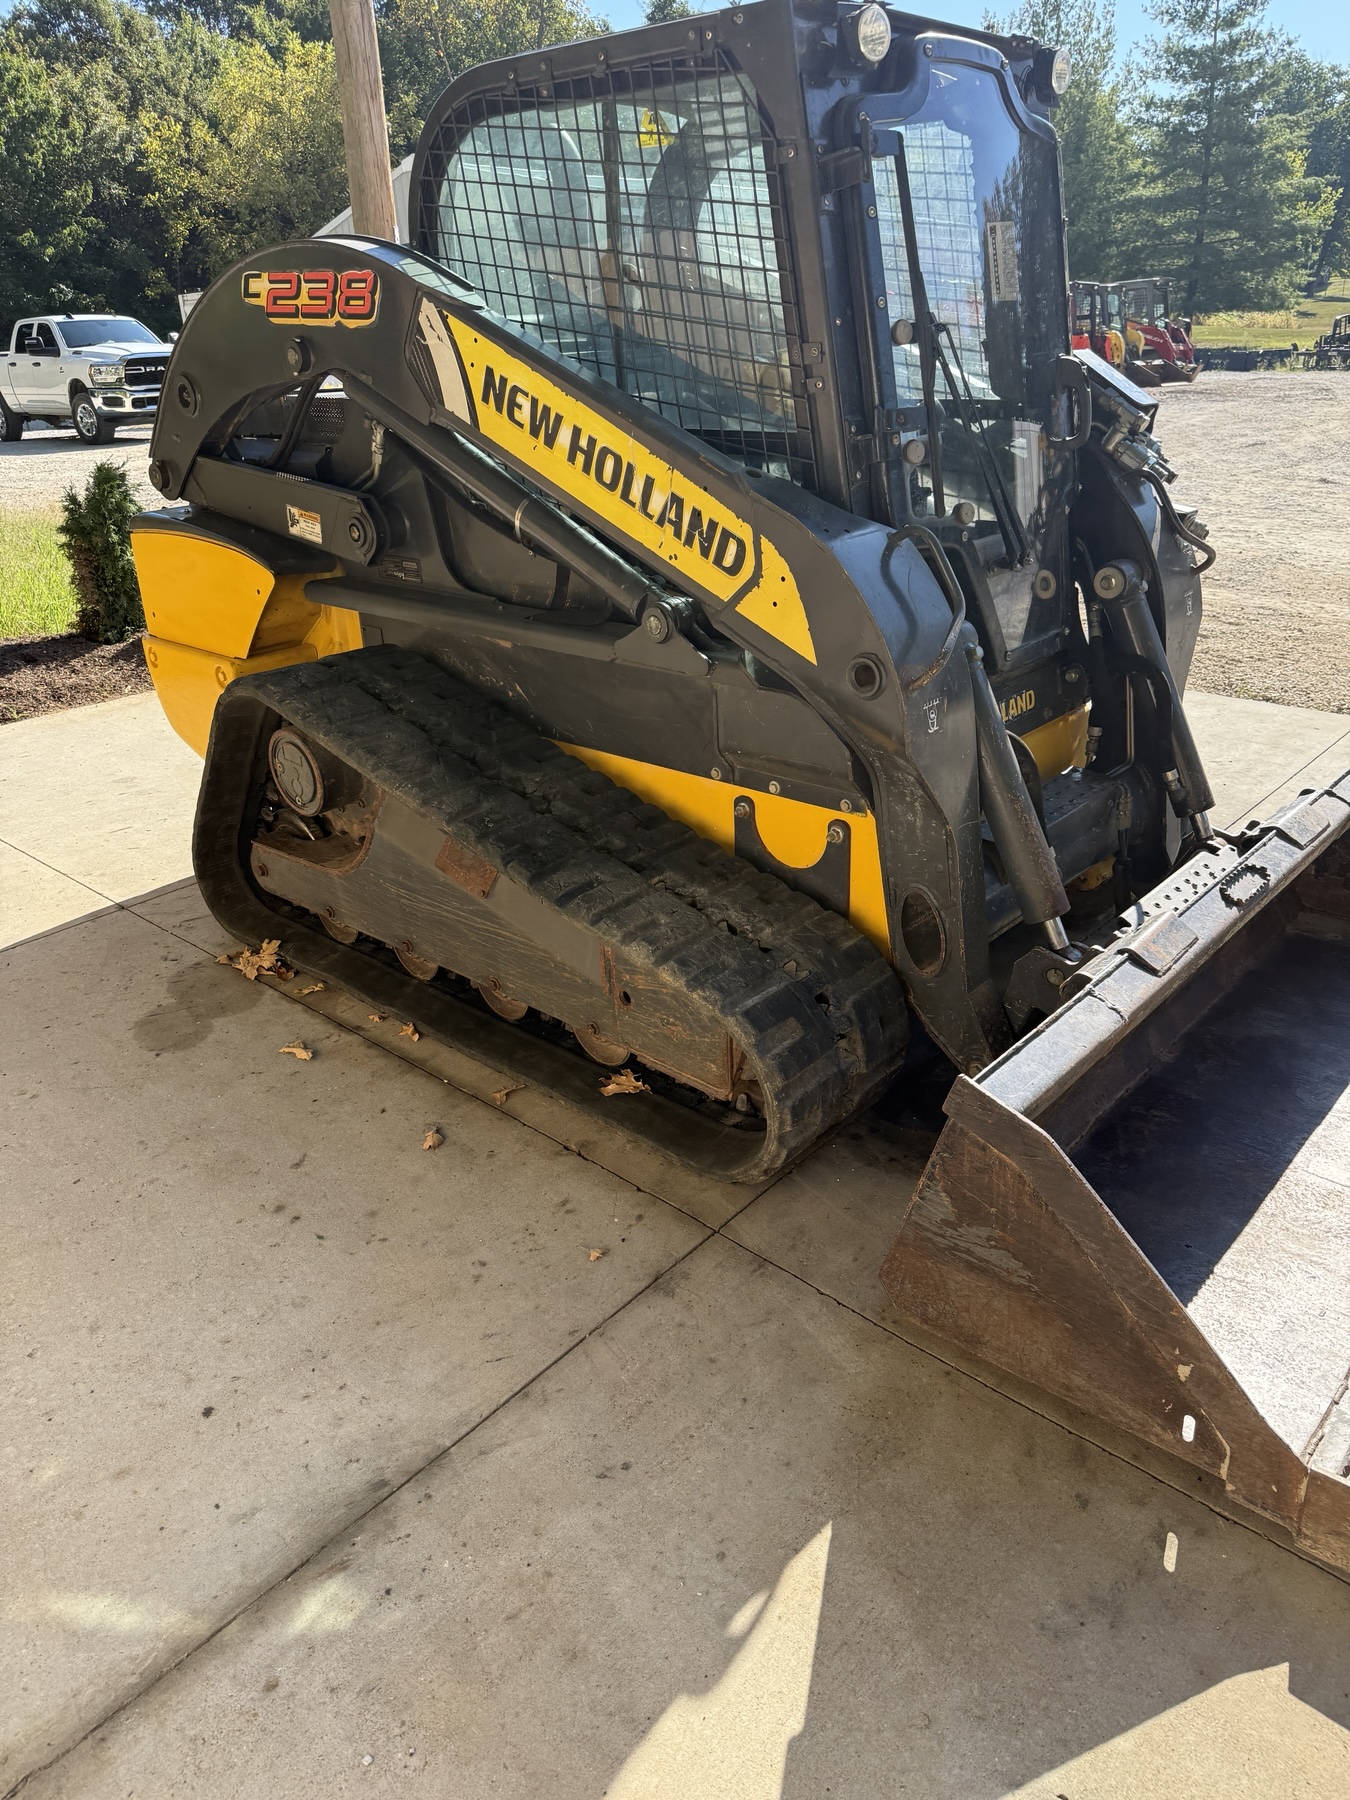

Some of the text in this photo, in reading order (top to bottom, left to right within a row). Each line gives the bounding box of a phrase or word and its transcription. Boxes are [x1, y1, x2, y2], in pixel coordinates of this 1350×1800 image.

[243, 270, 378, 320] C238
[480, 364, 747, 577] NEW HOLLAND
[1001, 690, 1035, 721] LAND
